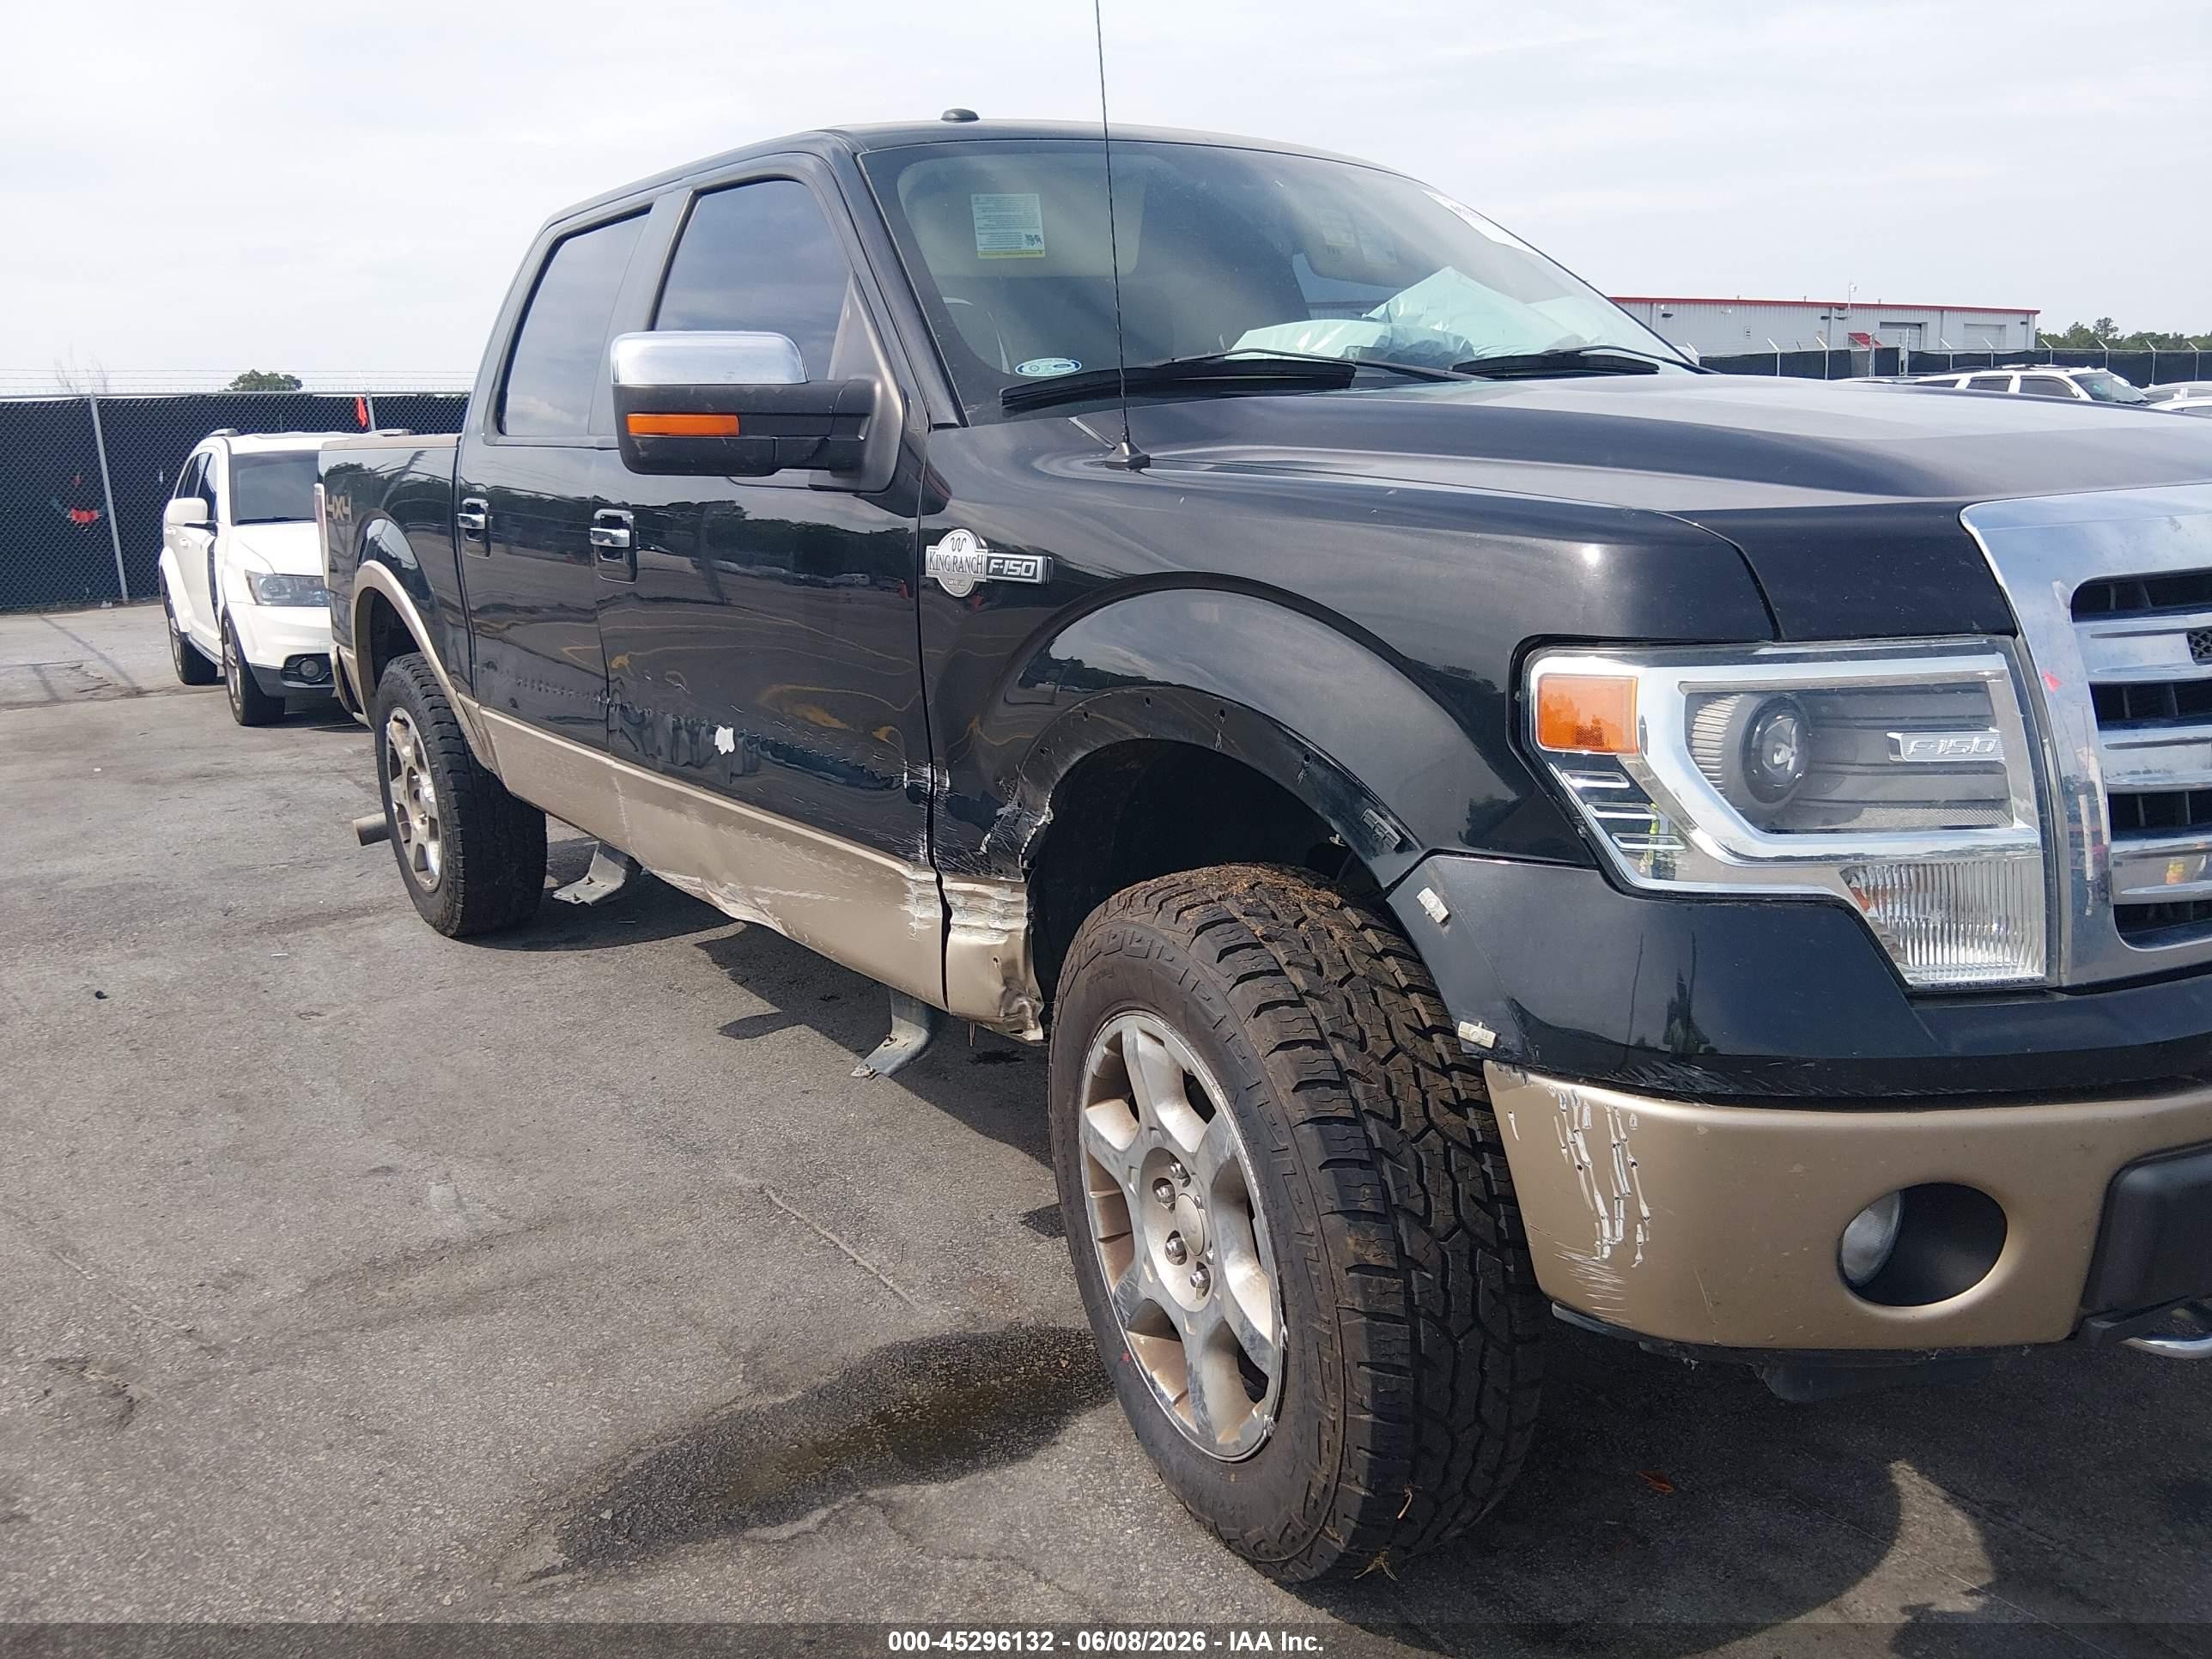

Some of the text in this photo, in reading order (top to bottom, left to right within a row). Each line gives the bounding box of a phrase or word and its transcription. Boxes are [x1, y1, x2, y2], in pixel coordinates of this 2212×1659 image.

[929, 551, 984, 574] KING RANCH
[988, 559, 1036, 577] F-150
[1906, 737, 1997, 755] F-150
